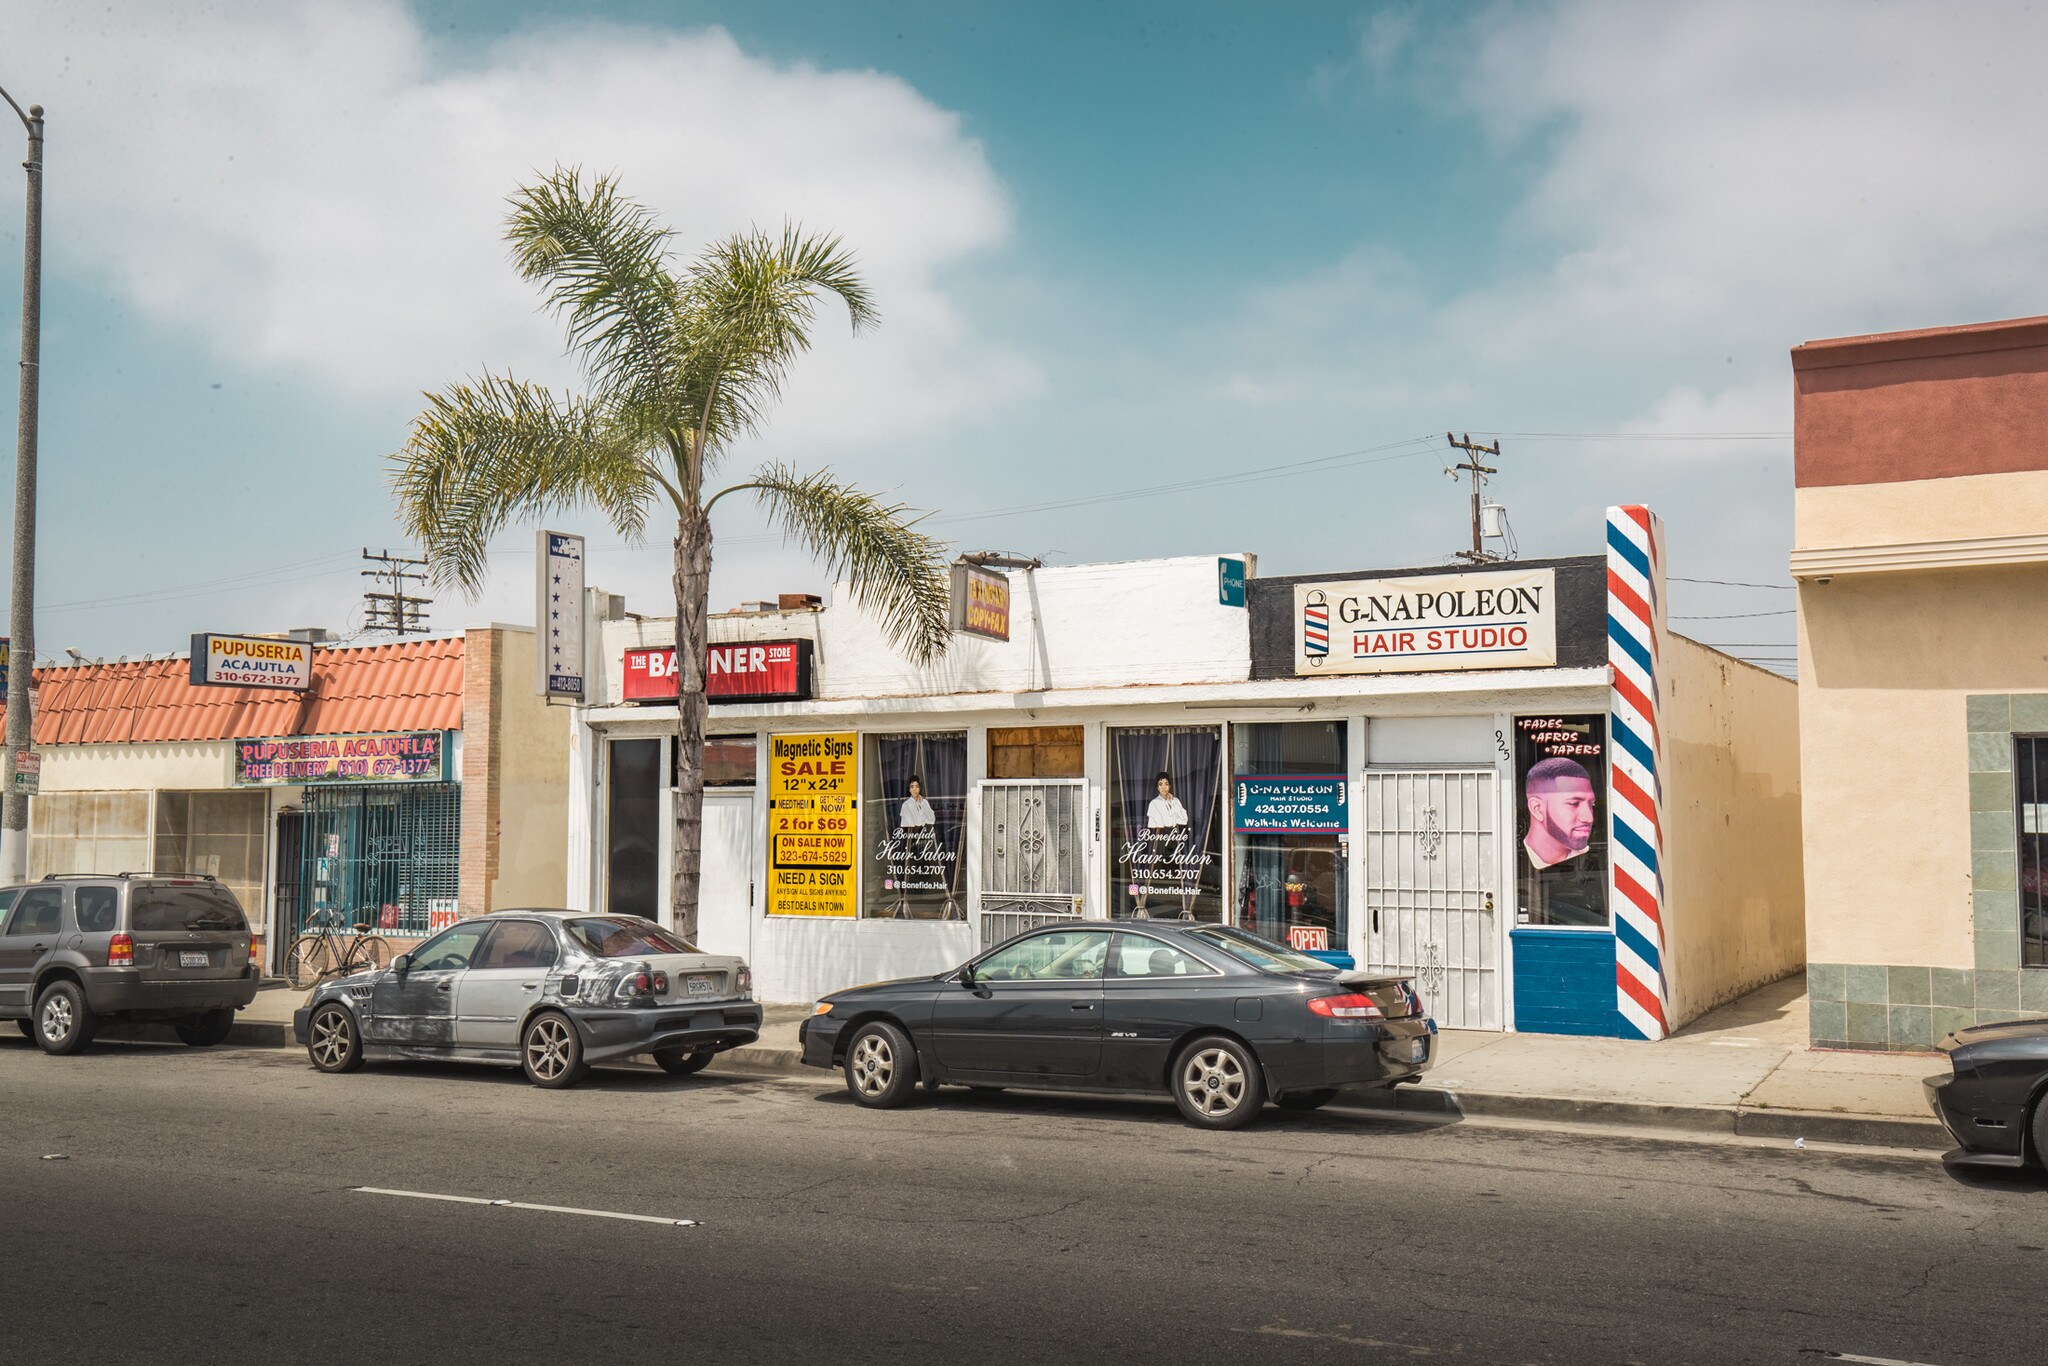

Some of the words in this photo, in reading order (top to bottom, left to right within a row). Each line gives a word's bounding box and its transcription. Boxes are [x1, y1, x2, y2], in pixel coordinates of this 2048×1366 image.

[1223, 577, 1244, 588] PHONE
[1339, 586, 1542, 624] G-NAPOLEON
[1353, 631, 1416, 654] HAIR
[1427, 626, 1528, 650] STUDIO
[211, 640, 304, 661] PUPUSERIA
[221, 659, 296, 674] ACAJUTLA
[631, 655, 646, 666] THE
[649, 647, 768, 677] BANER
[769, 647, 791, 658] STORE
[1523, 719, 1563, 730] FADES
[1536, 732, 1578, 743] AFROS
[242, 740, 340, 761] PUPUSERIA
[343, 737, 435, 757] ACAJUTLA
[775, 739, 821, 761] Magnetic
[824, 738, 853, 760] Signs
[1495, 730, 1510, 761] 925
[1551, 745, 1601, 755] TAPERS
[245, 761, 272, 779] FREE
[274, 760, 328, 778] DELIVERY
[337, 759, 369, 777] (310)
[373, 758, 432, 775] 672-1377
[781, 761, 846, 776] SALE
[808, 781, 816, 791] x
[778, 800, 793, 809] NEED
[820, 796, 829, 804] GET
[831, 796, 845, 804] THEM
[820, 804, 846, 812] NOW!
[1255, 804, 1329, 814] 424.207.0554
[780, 818, 789, 830] 2
[792, 818, 814, 830] for
[817, 817, 848, 831] $69
[1290, 818, 1340, 828] Welcome
[782, 838, 795, 847] ON
[797, 838, 821, 847] SALE
[824, 838, 846, 848] NOW
[1137, 828, 1189, 847] Bonefide
[780, 850, 847, 862] 323-674-5629
[875, 840, 914, 861] Hair
[914, 840, 957, 861] Salon
[1118, 842, 1161, 864] Hair
[1162, 842, 1213, 865] Salon
[887, 865, 946, 875] 310.654.2707
[1131, 869, 1200, 880] 310.654.2707
[778, 872, 806, 885] NEED
[808, 873, 816, 885] A
[819, 873, 844, 885] SIGN
[777, 901, 794, 910] BEST
[795, 901, 817, 911] DEALS
[818, 901, 825, 911] IN
[825, 902, 844, 911] TOWN
[431, 911, 458, 928] OPEN
[1293, 929, 1326, 950] OPEN
